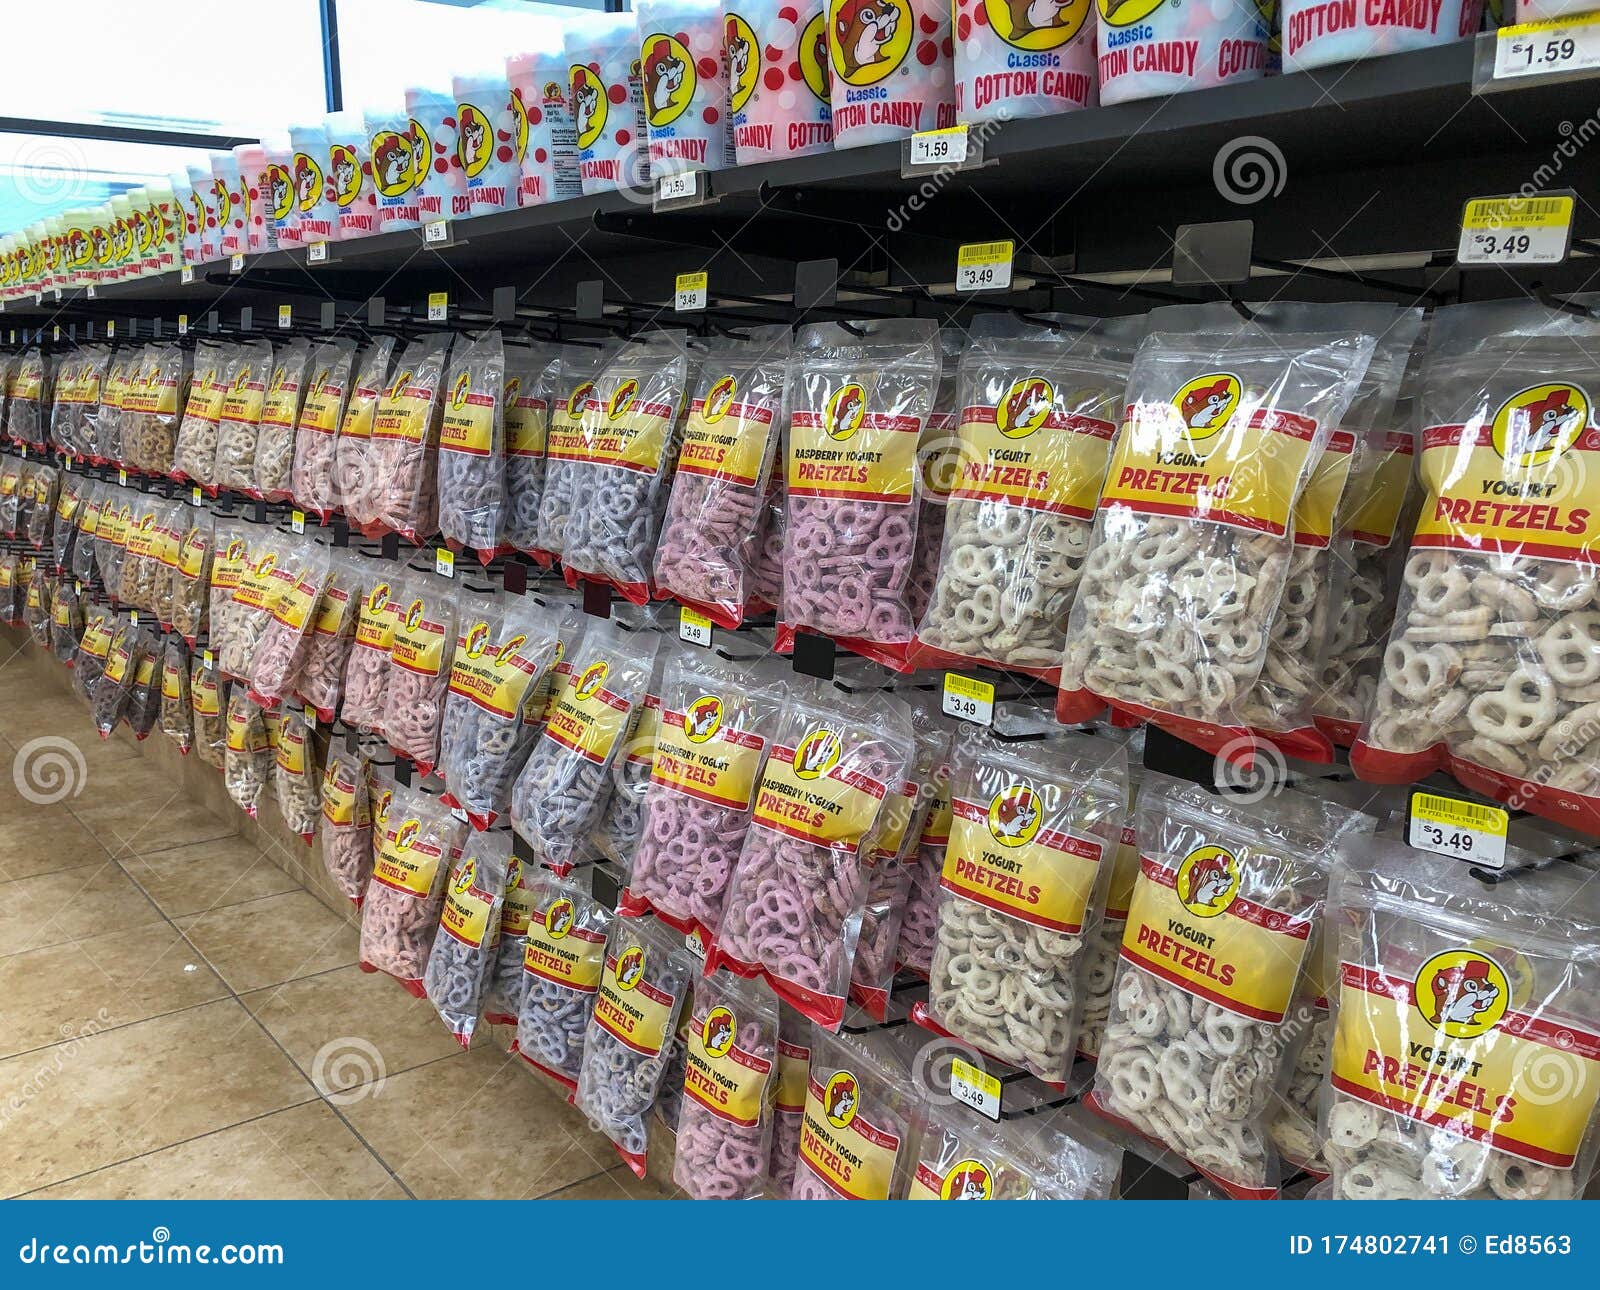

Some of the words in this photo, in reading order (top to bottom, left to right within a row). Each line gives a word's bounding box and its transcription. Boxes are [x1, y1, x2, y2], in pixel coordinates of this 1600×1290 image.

[1288, 1, 1356, 56] COTTON
[1364, 0, 1442, 34] CANDY
[1098, 47, 1128, 85] TTON
[1133, 40, 1198, 77] CANDY
[1512, 39, 1575, 64] $1.59
[974, 70, 1037, 110] COTTON
[1042, 70, 1092, 108] CANDY
[833, 104, 866, 137] OTTON
[871, 102, 922, 130] CANDY
[740, 125, 773, 150] CANDY
[788, 123, 833, 150] COTTO
[918, 141, 948, 157] $1.59
[666, 139, 707, 163] CANDY
[587, 160, 621, 181] CANDY
[475, 187, 506, 206] CANDY
[1475, 235, 1530, 254] $3.49
[964, 269, 993, 284] $3.49
[680, 293, 697, 305] $3.49
[711, 434, 738, 446] YOGURT
[795, 449, 843, 461] RASPBERRY
[846, 451, 882, 463] YOGURT
[988, 448, 1031, 463] YOGURT
[1156, 452, 1209, 468] YOGURT
[798, 463, 868, 484] PRETZELS
[962, 462, 1050, 491] PRETZELS
[1117, 466, 1233, 498] PRETZELS
[1481, 479, 1557, 498] YOGURT
[1434, 496, 1591, 535] PRETZELS
[950, 696, 976, 715] $3.49
[656, 754, 717, 787] PRETZELS
[759, 791, 827, 829] PRETZELS
[804, 793, 843, 816] YOGURT
[1424, 825, 1473, 851] $3.49
[982, 850, 1023, 875] YOGURT
[955, 857, 1041, 906] PRETZELS
[1168, 919, 1215, 950] YOGURT
[527, 949, 572, 976] PRETZELS
[556, 946, 580, 963] YOGURT
[1137, 923, 1236, 987] PRETZELS
[621, 1001, 645, 1022] YOGURT
[712, 1069, 739, 1092] YOGURT
[1362, 1049, 1518, 1124] PRETZELS
[958, 1082, 984, 1105] $3.49
[804, 1112, 836, 1150] RASPBERRY
[835, 1140, 864, 1169] YOGURT
[803, 1127, 852, 1183] PRETZELS
